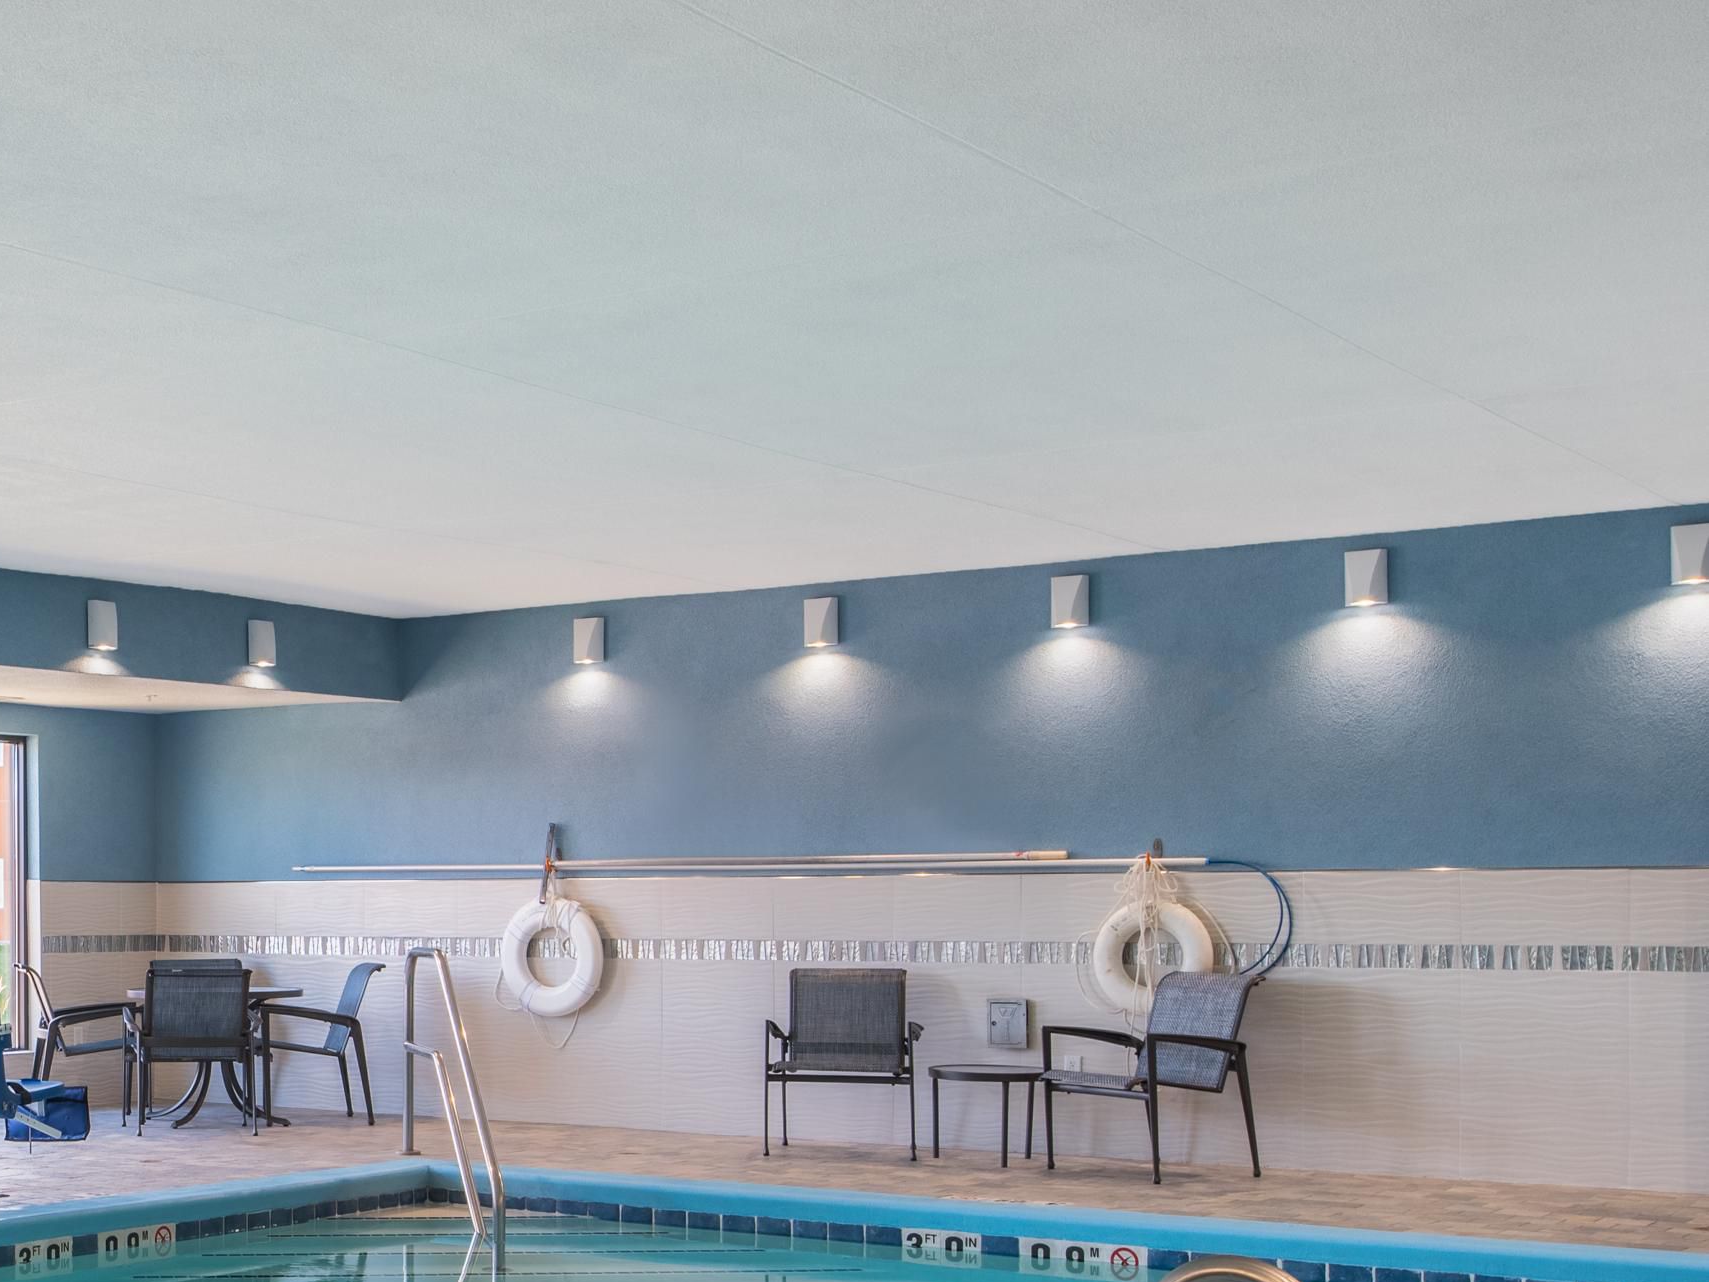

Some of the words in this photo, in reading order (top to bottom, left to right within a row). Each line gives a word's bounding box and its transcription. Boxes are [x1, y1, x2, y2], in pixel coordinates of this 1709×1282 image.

[33, 1245, 41, 1256] FT
[61, 1241, 70, 1252] IN
[142, 1230, 148, 1240] M
[925, 1233, 937, 1244] FT
[965, 1237, 977, 1248] IN
[1090, 1247, 1099, 1258] M
